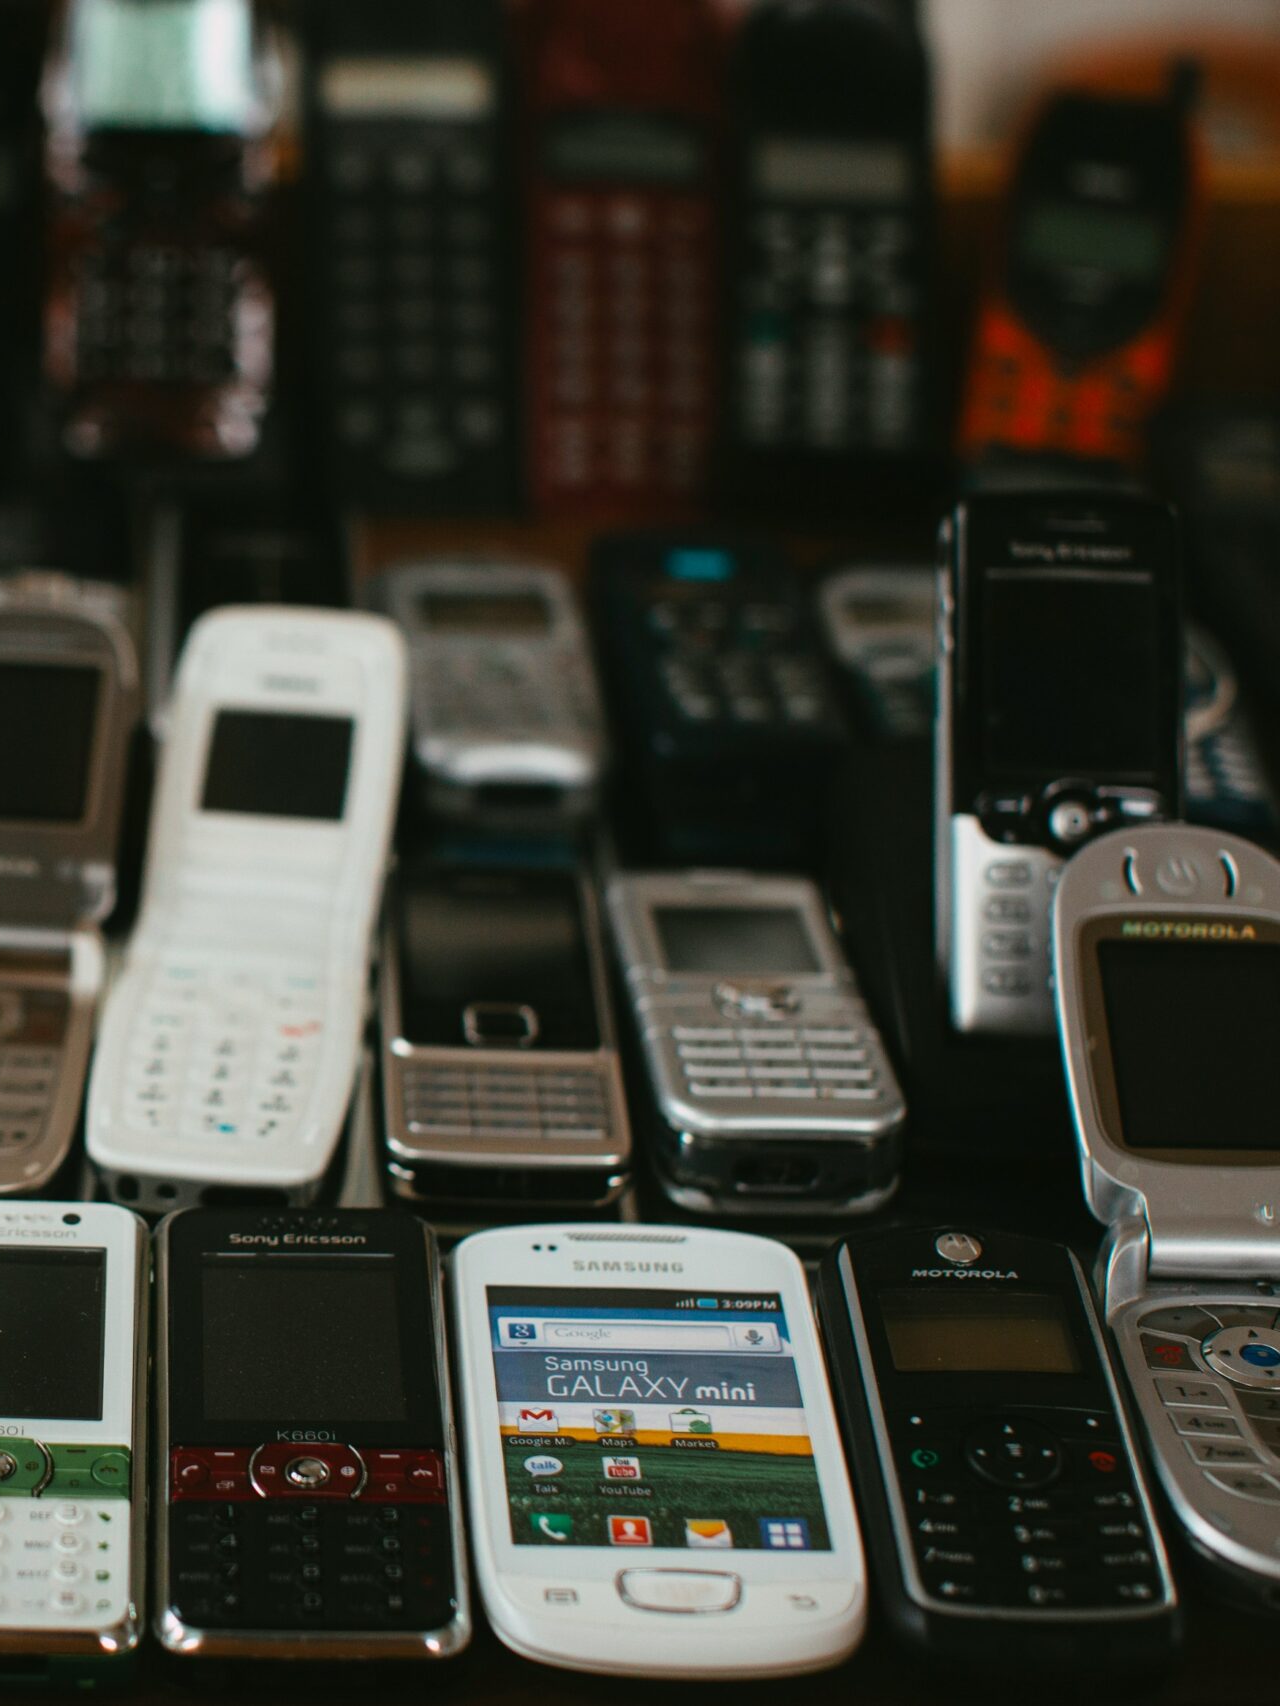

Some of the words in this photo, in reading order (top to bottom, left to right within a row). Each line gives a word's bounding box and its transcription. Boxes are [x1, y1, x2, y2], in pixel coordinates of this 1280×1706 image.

[1122, 921, 1256, 939] MOTOROLA
[229, 1233, 278, 1245] Sony
[283, 1233, 366, 1245] Ericsson
[572, 1260, 684, 1273] SAMSUNG
[911, 1268, 1018, 1280] MOTOROLA
[722, 1299, 777, 1310] 3:09PM
[554, 1328, 612, 1340] Google
[545, 1356, 649, 1376] Samsung
[546, 1375, 690, 1398] GALAXY
[696, 1382, 756, 1400] mini
[277, 1430, 336, 1441] K660i
[509, 1437, 551, 1446] Google
[602, 1439, 634, 1447] Maps
[675, 1440, 715, 1448] Market
[531, 1460, 557, 1471] talk
[613, 1458, 630, 1466] You
[611, 1467, 634, 1477] Tube
[535, 1484, 558, 1494] Talk
[600, 1486, 651, 1497] YouTube
[62, 1505, 77, 1519] 3
[301, 1506, 318, 1520] 2
[384, 1507, 399, 1521] 3
[220, 1533, 237, 1547] 4
[302, 1535, 319, 1548] 5
[383, 1536, 400, 1549] 6
